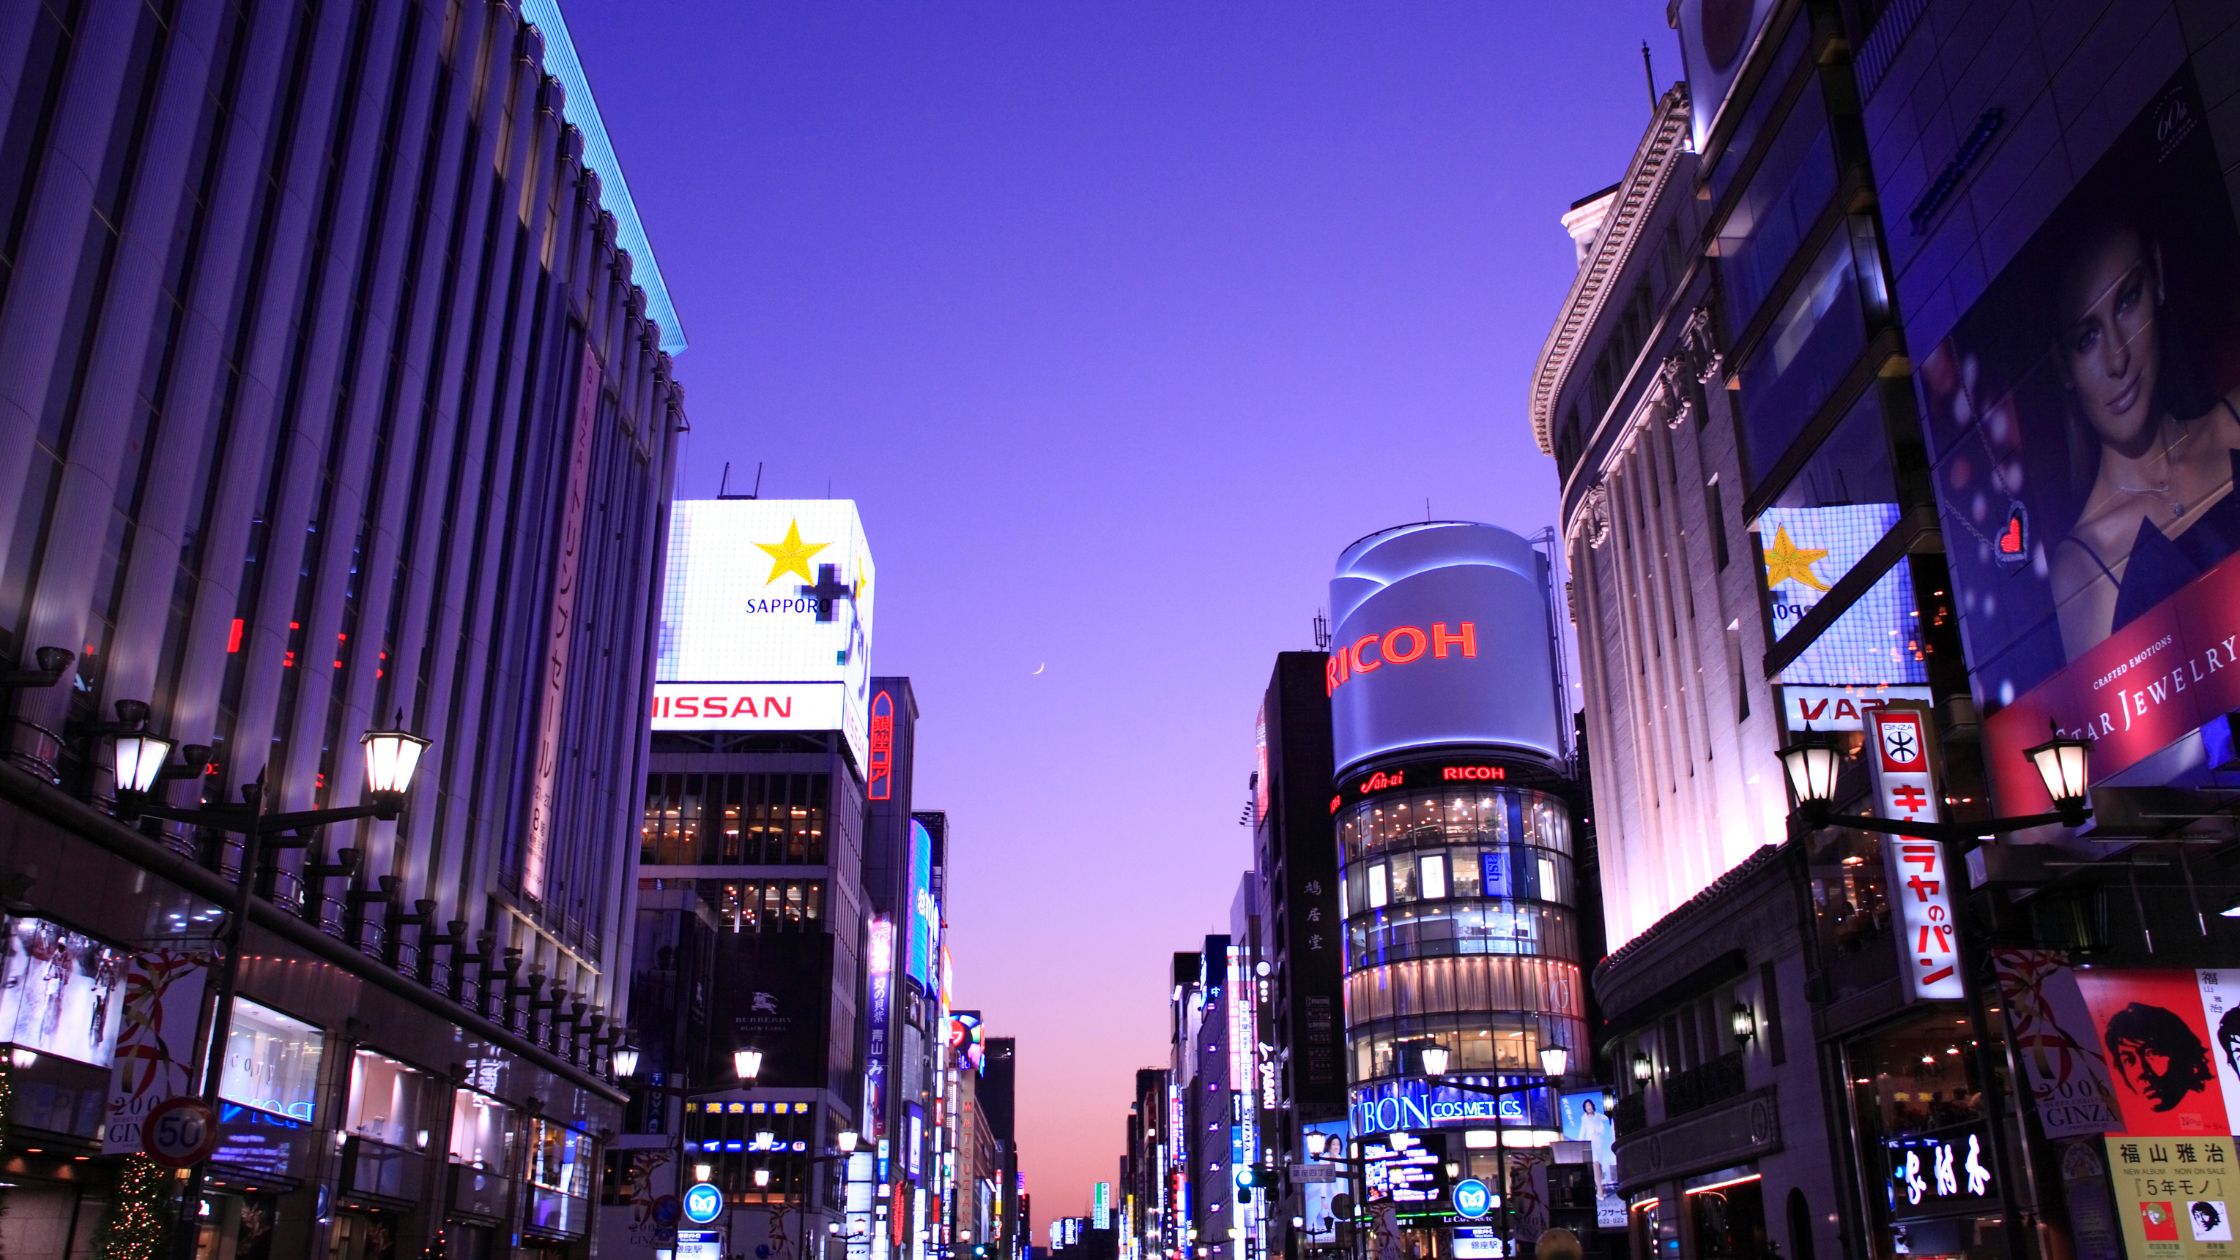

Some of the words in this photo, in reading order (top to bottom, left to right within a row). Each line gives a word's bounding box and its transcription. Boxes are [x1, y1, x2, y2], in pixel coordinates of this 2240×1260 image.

[746, 598, 830, 614] SAPPORO
[1326, 622, 1477, 697] RICOH
[2093, 663, 2128, 690] CRAFTED
[2129, 634, 2173, 668] EMOTIONS
[2118, 634, 2239, 732] JEWELRY
[1883, 723, 1913, 731] GINZA
[872, 716, 890, 783] 銀座コア
[1442, 766, 1505, 781] RICOH
[1303, 880, 1323, 951] 鳩居堂
[113, 1096, 163, 1116] 200
[2046, 1104, 2119, 1127] GINZA
[158, 1117, 201, 1148] 50
[2120, 1143, 2225, 1164] 福山雅治
[2207, 1167, 2226, 1175] SALE
